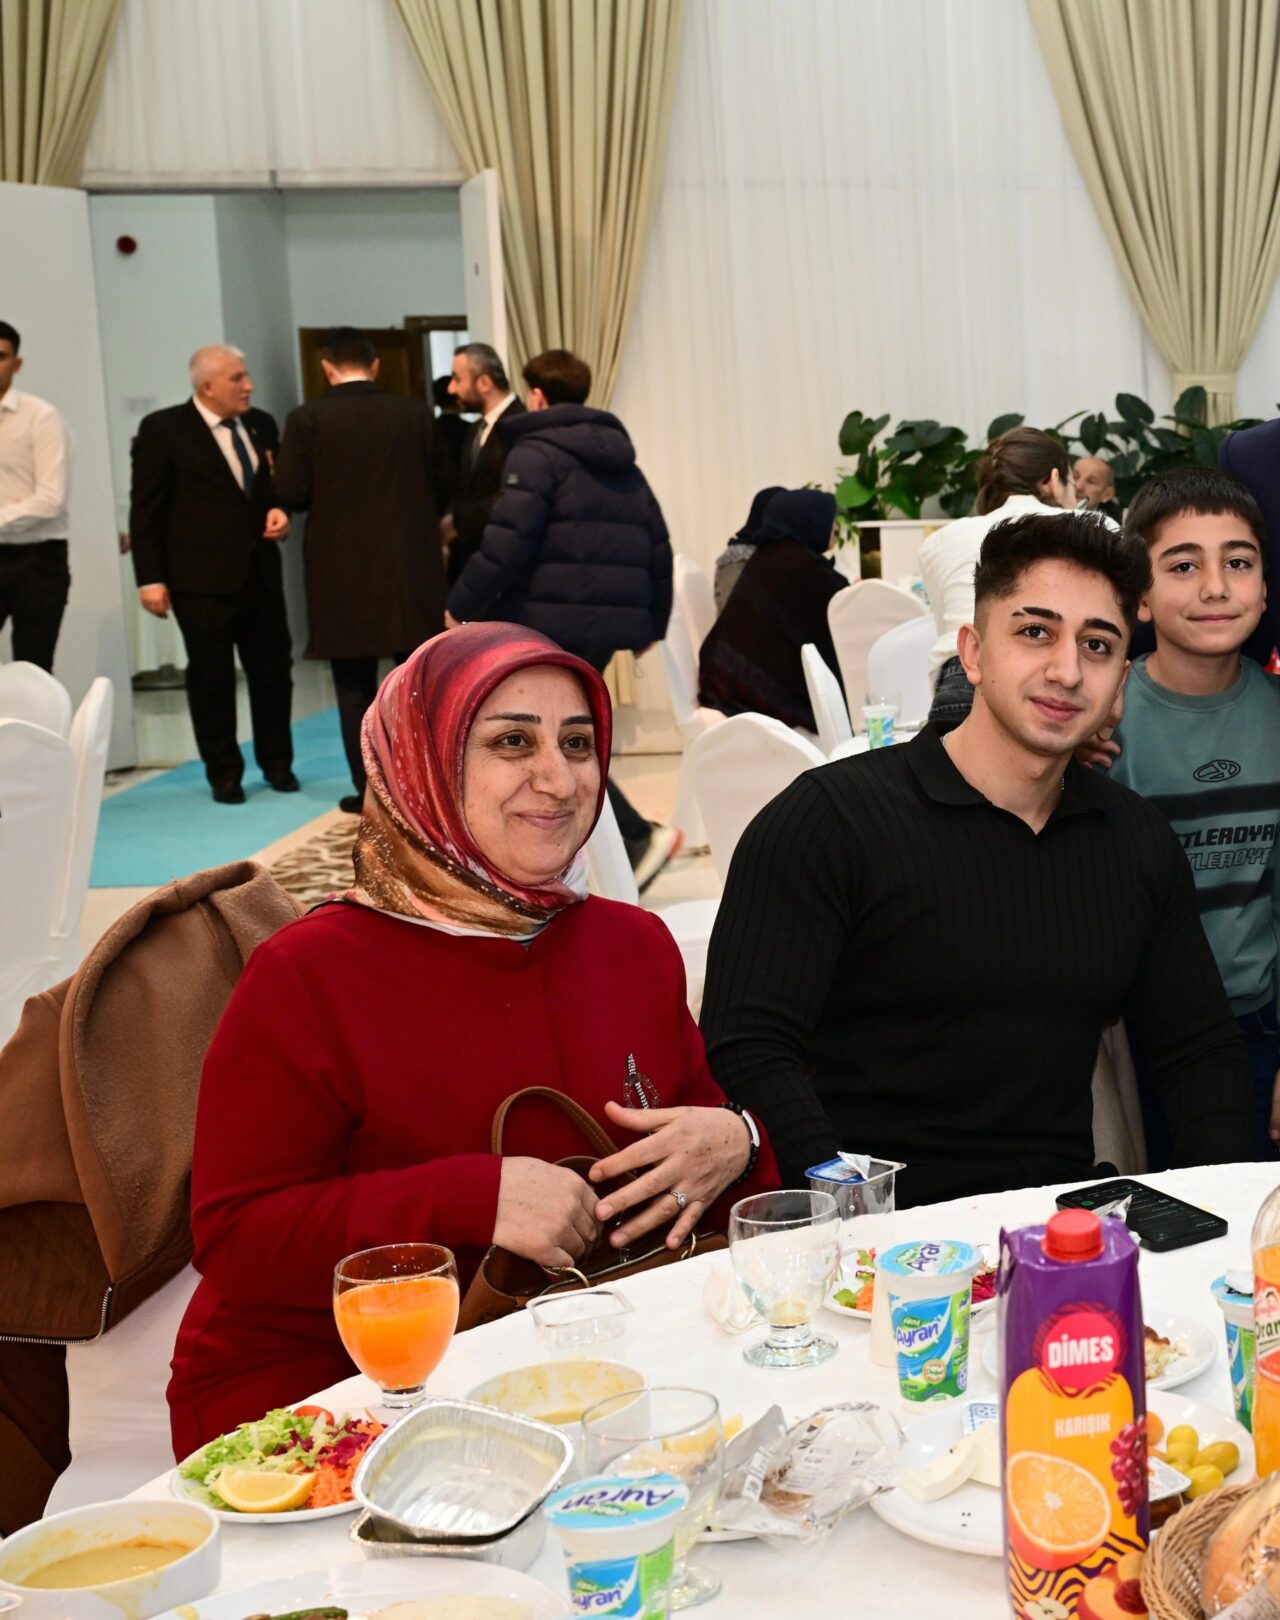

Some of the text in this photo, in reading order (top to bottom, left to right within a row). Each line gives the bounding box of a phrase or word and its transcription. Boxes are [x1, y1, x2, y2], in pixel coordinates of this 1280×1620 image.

[896, 1322, 939, 1347] Ayran
[1048, 1333, 1114, 1369] DİMES
[1054, 1412, 1111, 1440] KARIŞIK
[561, 1488, 675, 1511] Ayran
